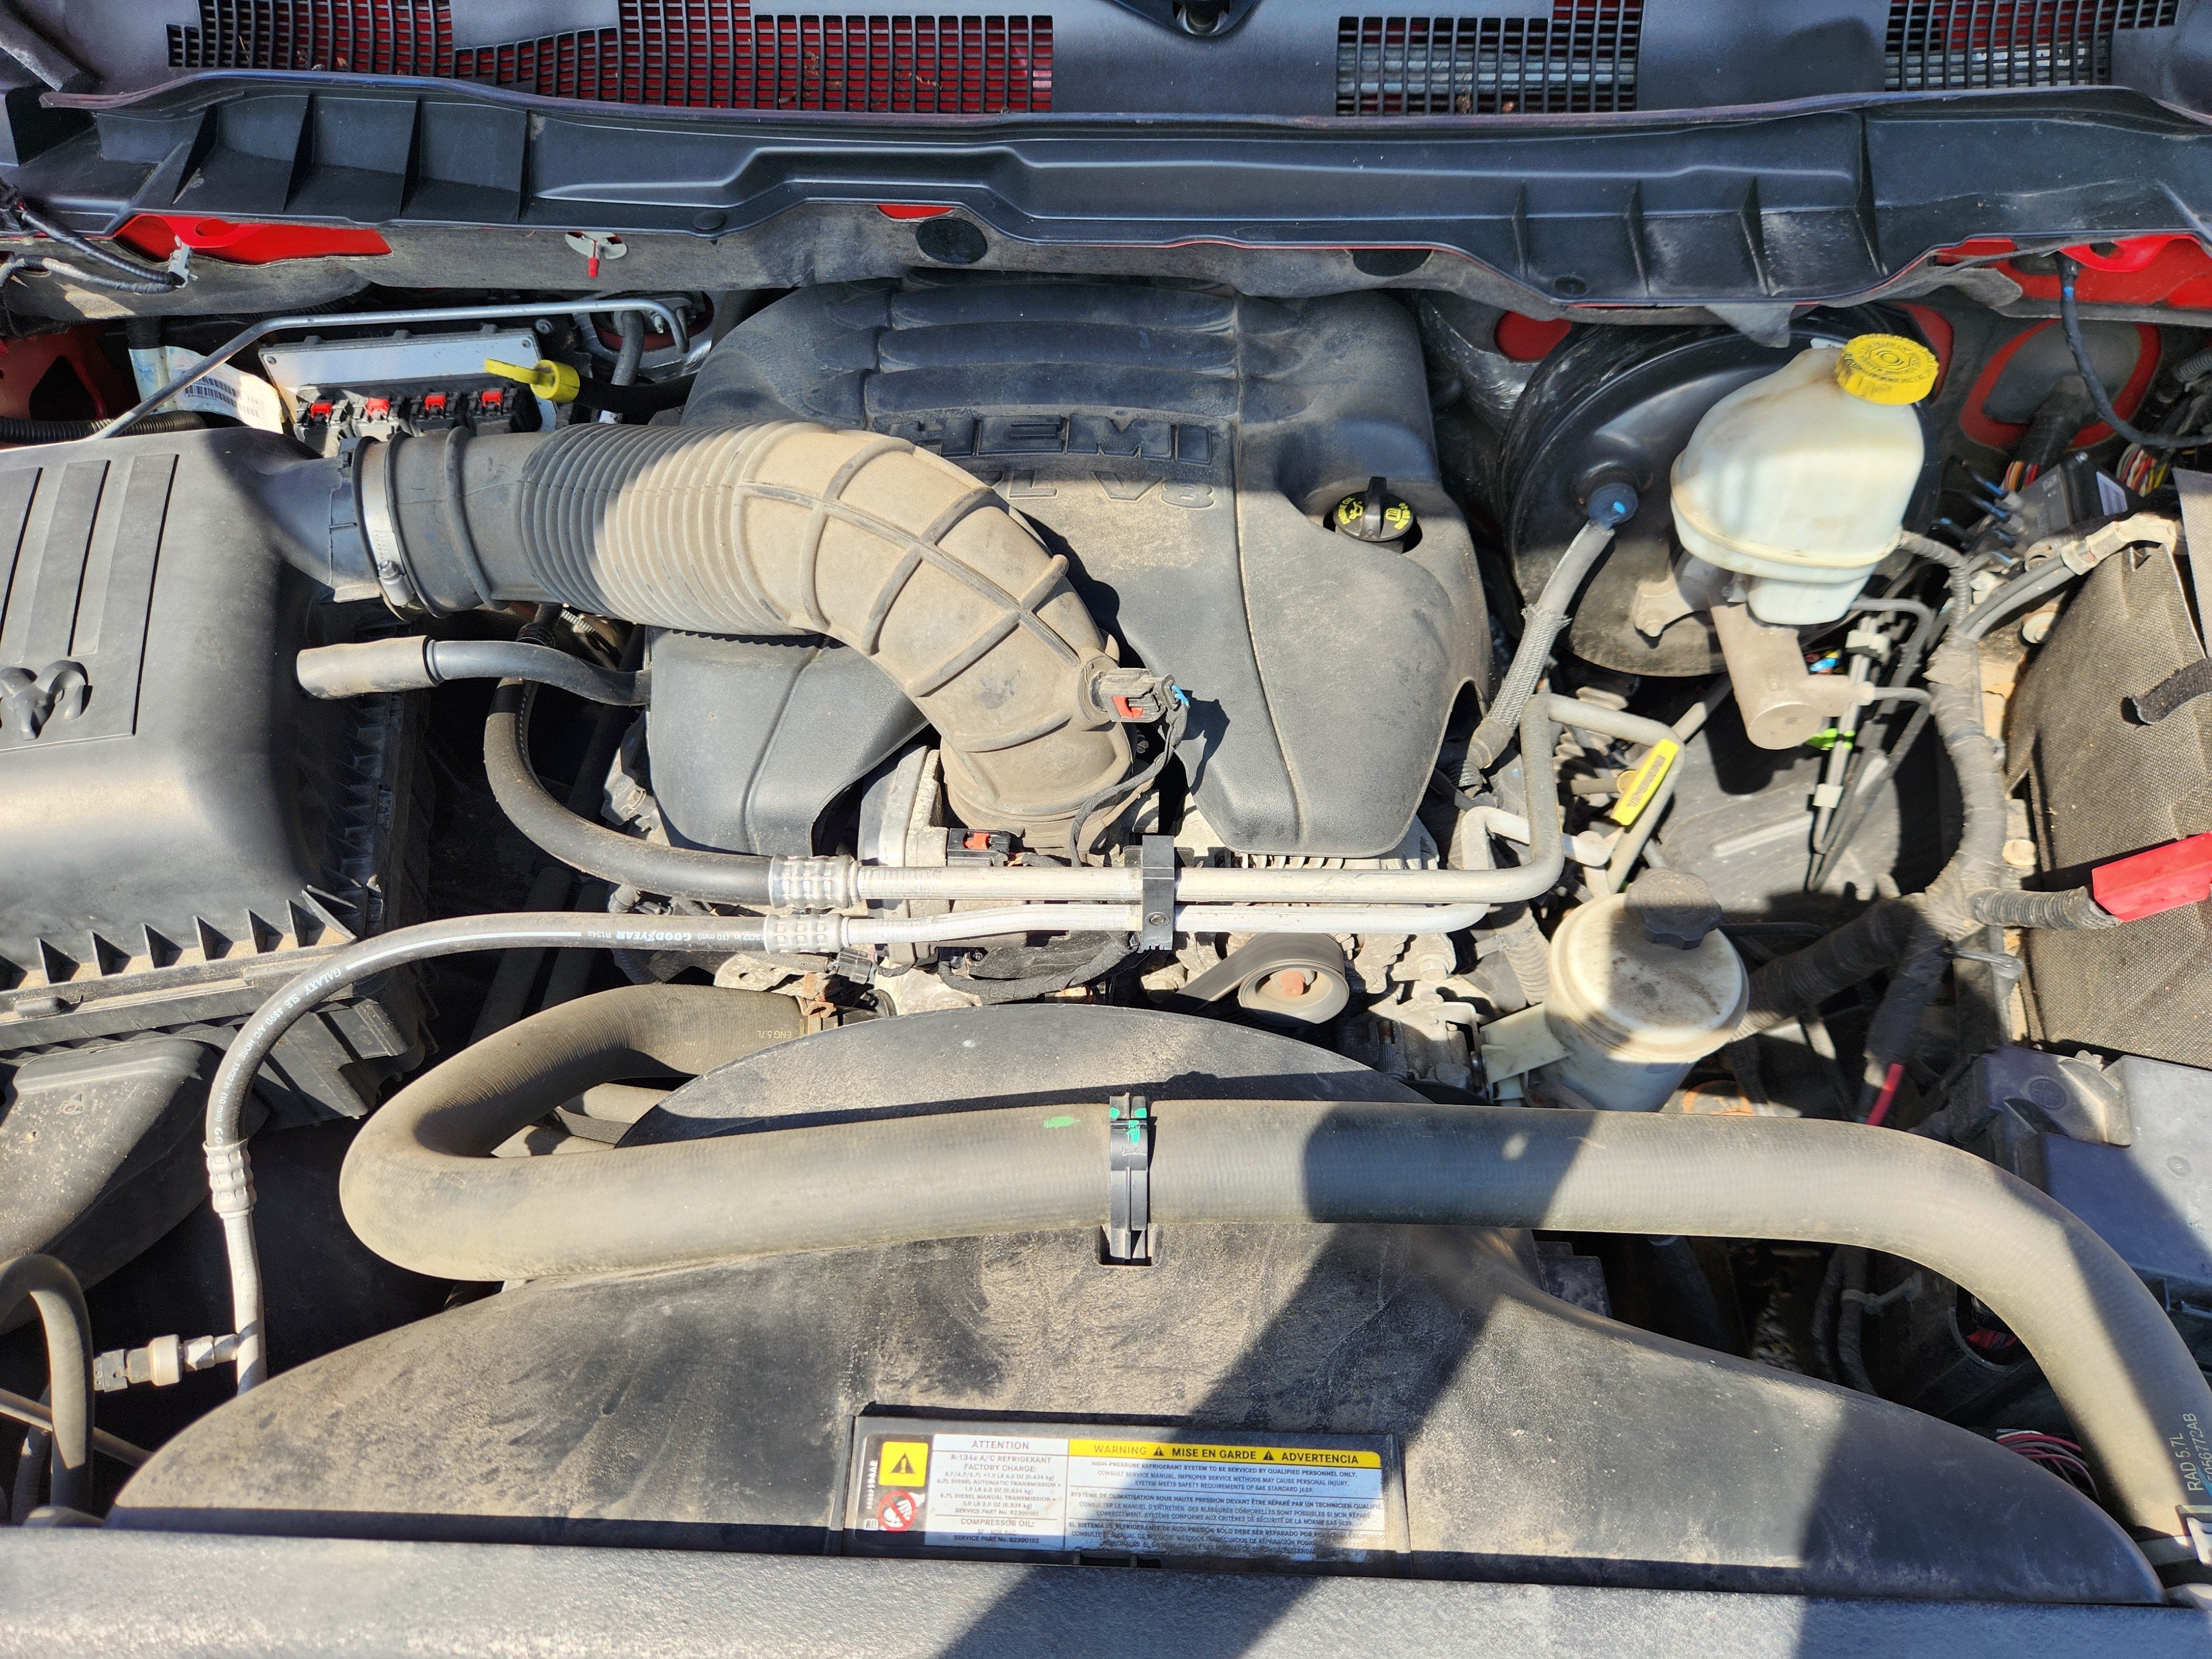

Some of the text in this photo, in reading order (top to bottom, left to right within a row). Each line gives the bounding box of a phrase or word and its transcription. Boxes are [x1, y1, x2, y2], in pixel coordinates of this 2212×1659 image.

[889, 414, 1212, 466] HEMI
[1092, 469, 1217, 510] V8
[1627, 791, 1642, 807] OIL
[587, 931, 612, 939] R134a
[615, 930, 692, 941] GOODYEAR
[697, 932, 716, 941] mm)
[717, 932, 729, 941] (10
[304, 968, 341, 995] GALAXY
[284, 994, 301, 1009] SLE
[265, 1008, 283, 1025] 4890
[254, 1024, 267, 1039] A/C
[757, 1030, 792, 1039] ENG 5.7L
[238, 1039, 255, 1061] HOSE
[227, 1063, 241, 1082] 13/32
[220, 1092, 228, 1104] (10
[57, 1100, 84, 1115] TOP
[215, 1106, 223, 1122] mm)
[972, 1440, 1029, 1450] ATTENTION
[2169, 1432, 2190, 1458] 5.7L
[997, 1455, 1051, 1463] REFRIGERANT
[1093, 1444, 1359, 1464] WARNING MISE EN GARDE ADVERTENCIA
[2180, 1462, 2204, 1490] RAD
[961, 1518, 1016, 1526] COMPRESSOR
